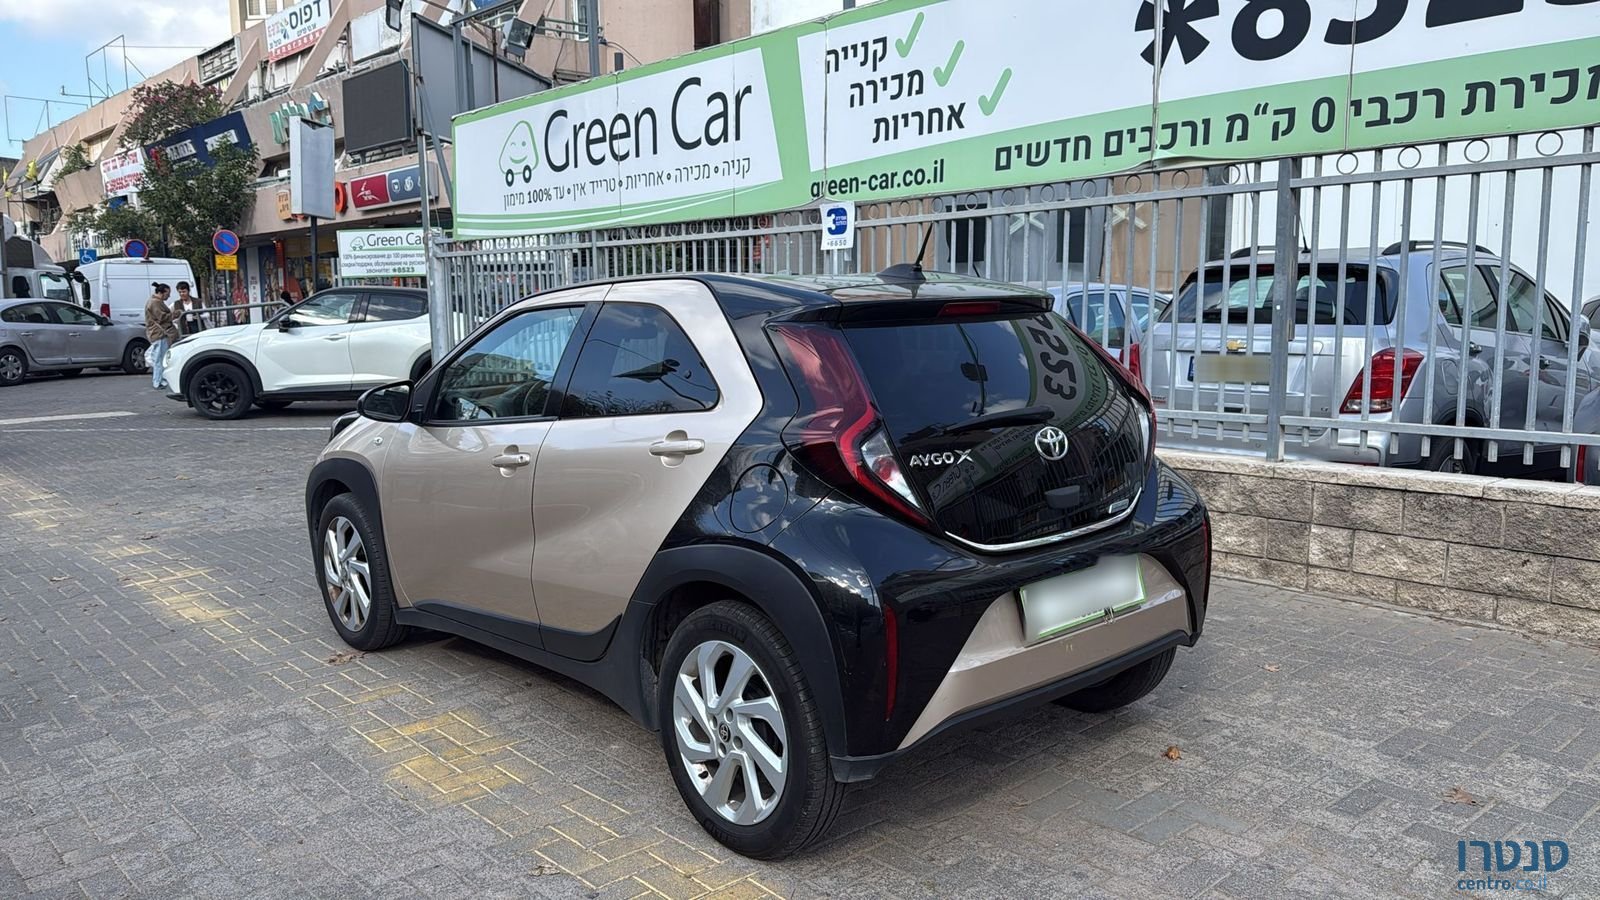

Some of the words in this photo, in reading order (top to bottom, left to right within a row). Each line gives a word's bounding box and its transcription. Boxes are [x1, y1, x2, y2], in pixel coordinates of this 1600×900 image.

[289, 0, 321, 30] דפוס
[826, 36, 889, 75] קנייה
[850, 69, 924, 108] מכירה
[1312, 97, 1336, 133] 0
[1350, 89, 1445, 128] רכבי
[544, 107, 658, 173] Green
[671, 76, 752, 151] Car
[873, 101, 966, 144] אחריות
[1104, 117, 1211, 158] ורכבים
[995, 135, 1092, 172] חדשים
[625, 169, 665, 191] אחריות
[674, 163, 711, 184] מכירה
[722, 157, 751, 180] קניה
[527, 187, 552, 204] 100%
[553, 186, 565, 200] עד
[572, 181, 587, 202] אין
[589, 177, 616, 194] טרייד
[503, 191, 525, 211] מימון
[366, 233, 403, 247] Green
[910, 453, 954, 468] AYGO
